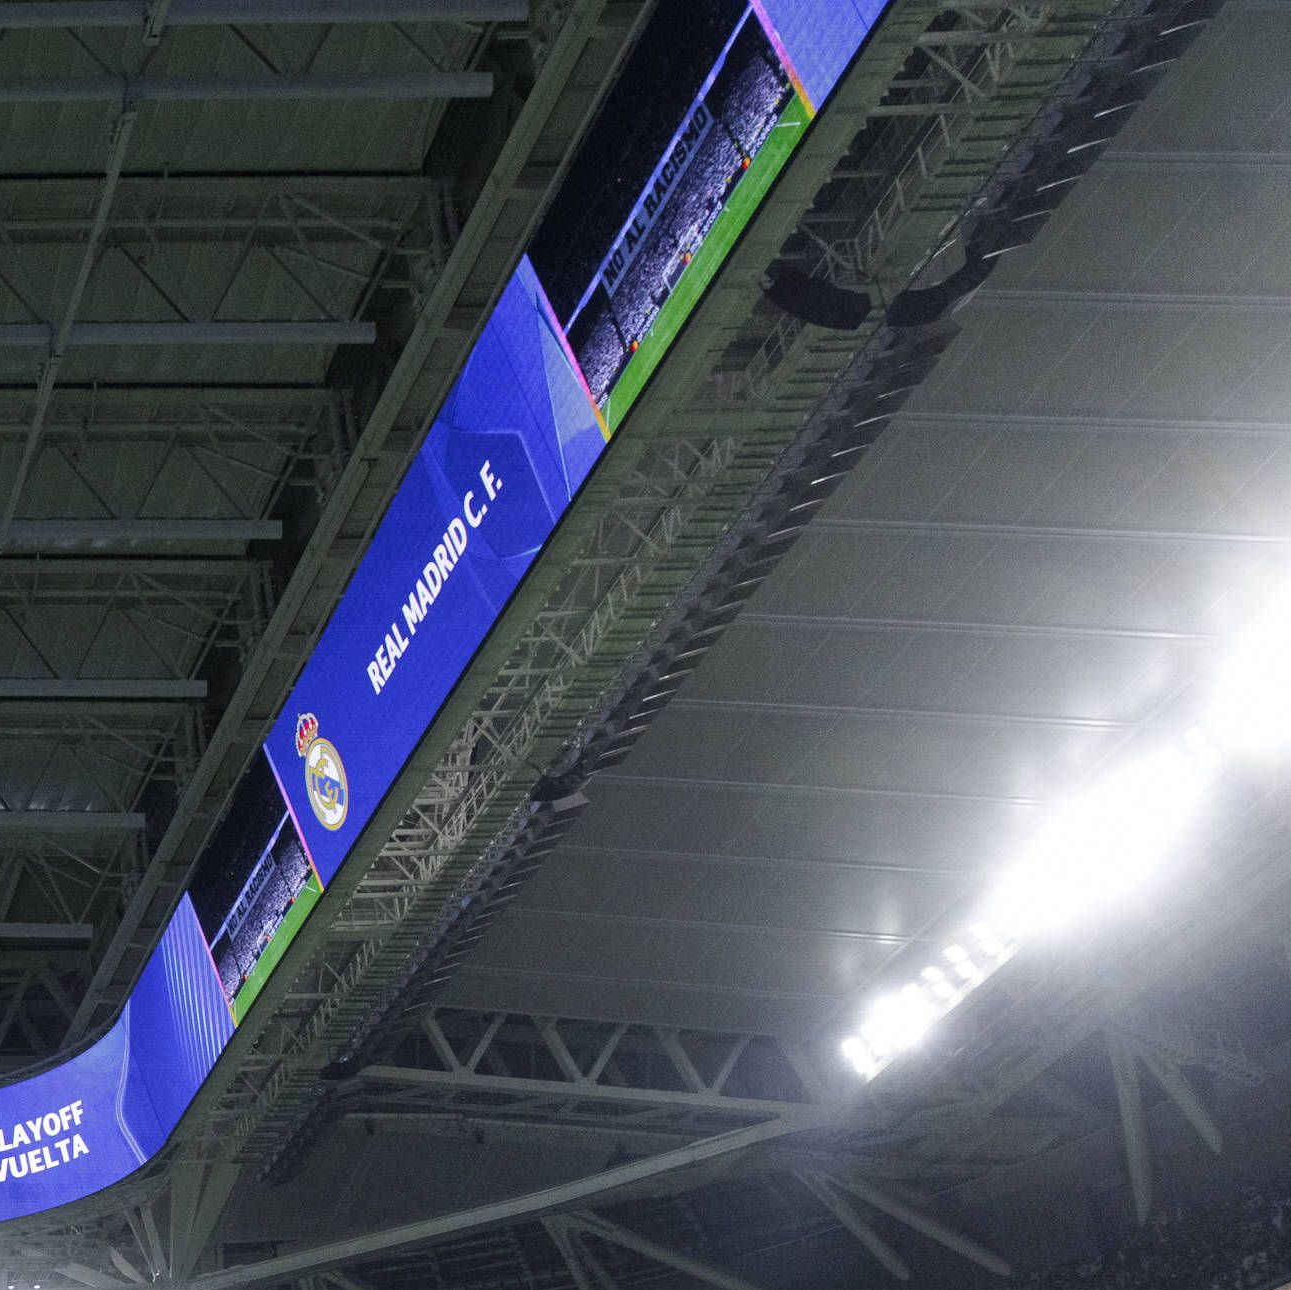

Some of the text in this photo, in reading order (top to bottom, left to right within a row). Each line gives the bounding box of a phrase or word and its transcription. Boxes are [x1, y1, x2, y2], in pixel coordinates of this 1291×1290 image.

[602, 247, 626, 286] NO
[624, 215, 645, 253] AL
[366, 459, 503, 696] REAL MADRID C. F.
